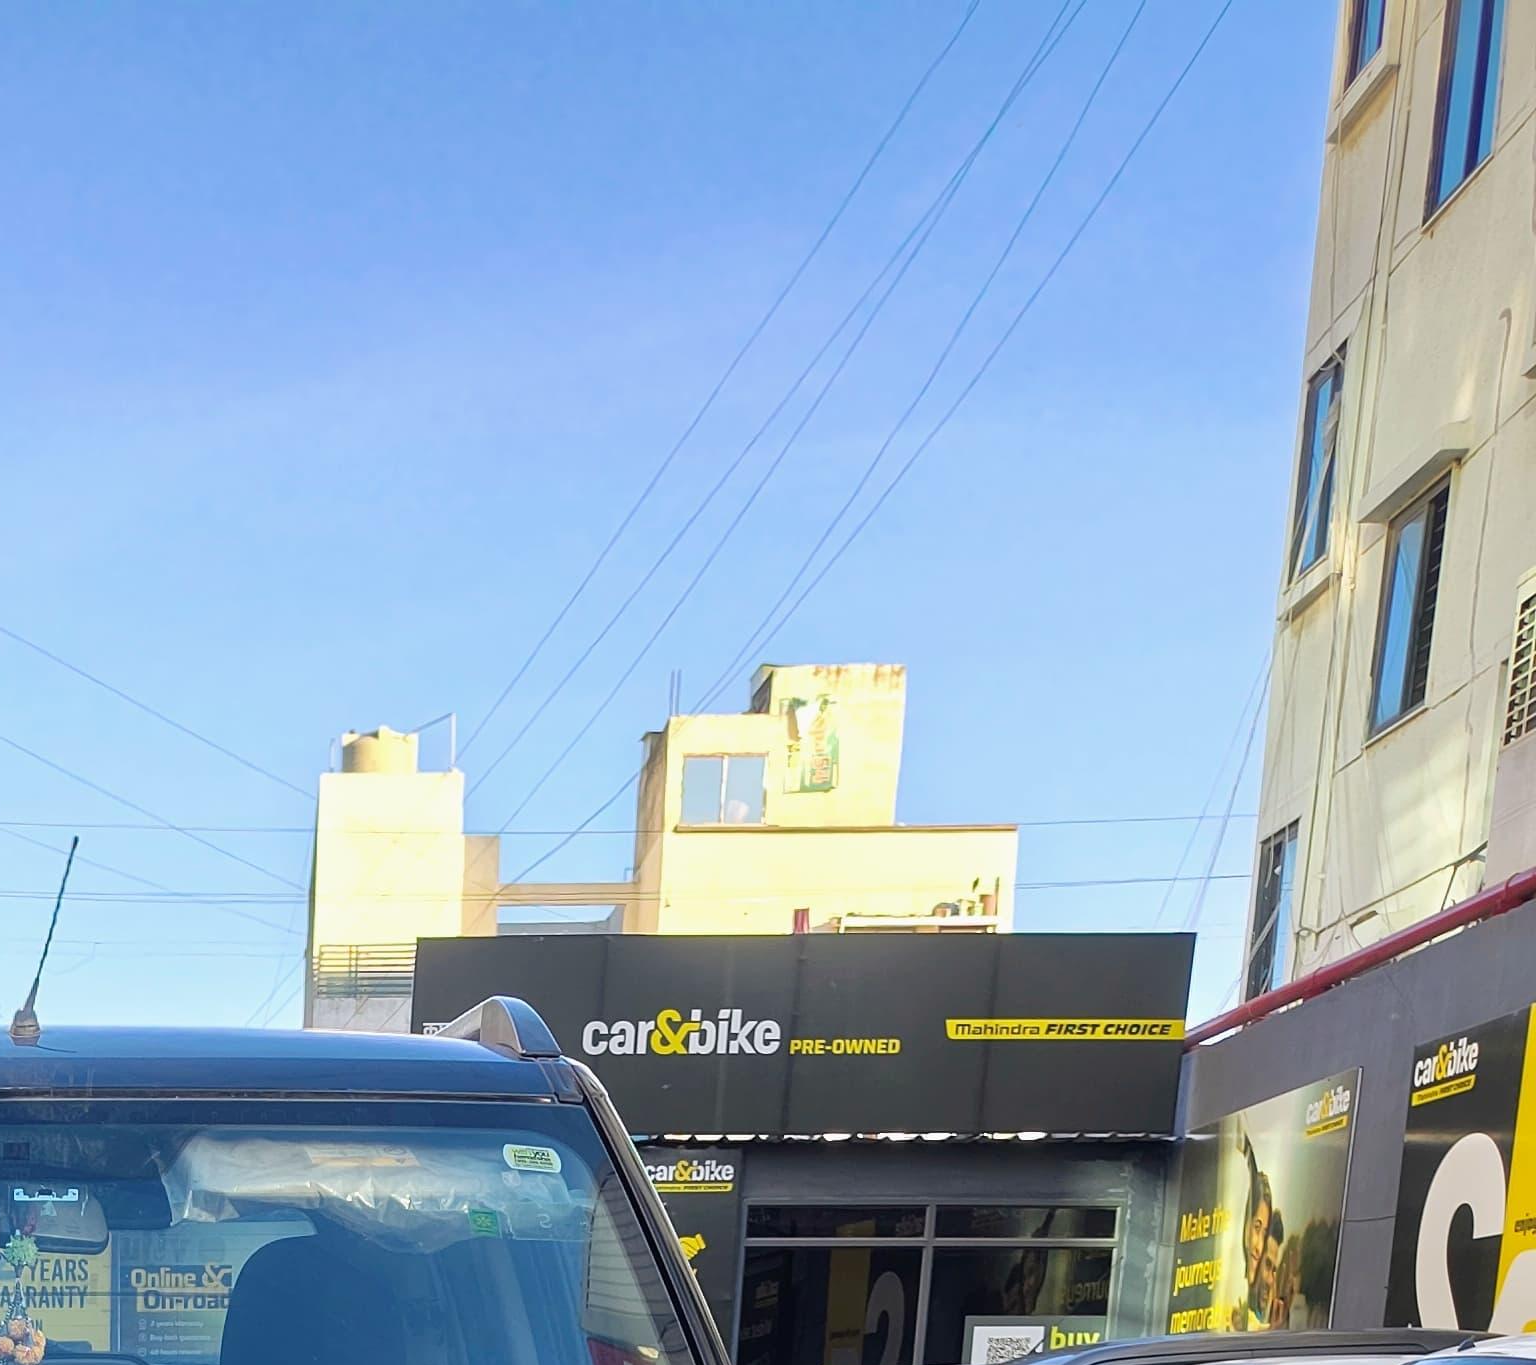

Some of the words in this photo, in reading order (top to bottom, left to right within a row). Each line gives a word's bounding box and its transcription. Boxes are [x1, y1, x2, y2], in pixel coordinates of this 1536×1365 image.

[582, 1008, 781, 1056] car&bike
[789, 1038, 901, 1056] PRE-OWNED
[955, 1023, 1040, 1036] Mahindra
[1044, 1023, 1100, 1035] FIRST
[1103, 1023, 1172, 1036] CHOICE
[1413, 1036, 1479, 1088] car&bike
[1306, 1086, 1351, 1125] car&bike
[645, 1159, 734, 1182] car&bike
[1179, 1208, 1210, 1243] Make
[28, 1258, 89, 1282] YEARS
[130, 1266, 197, 1288] Online
[202, 1261, 233, 1288] &
[1172, 1258, 1224, 1297] journeys
